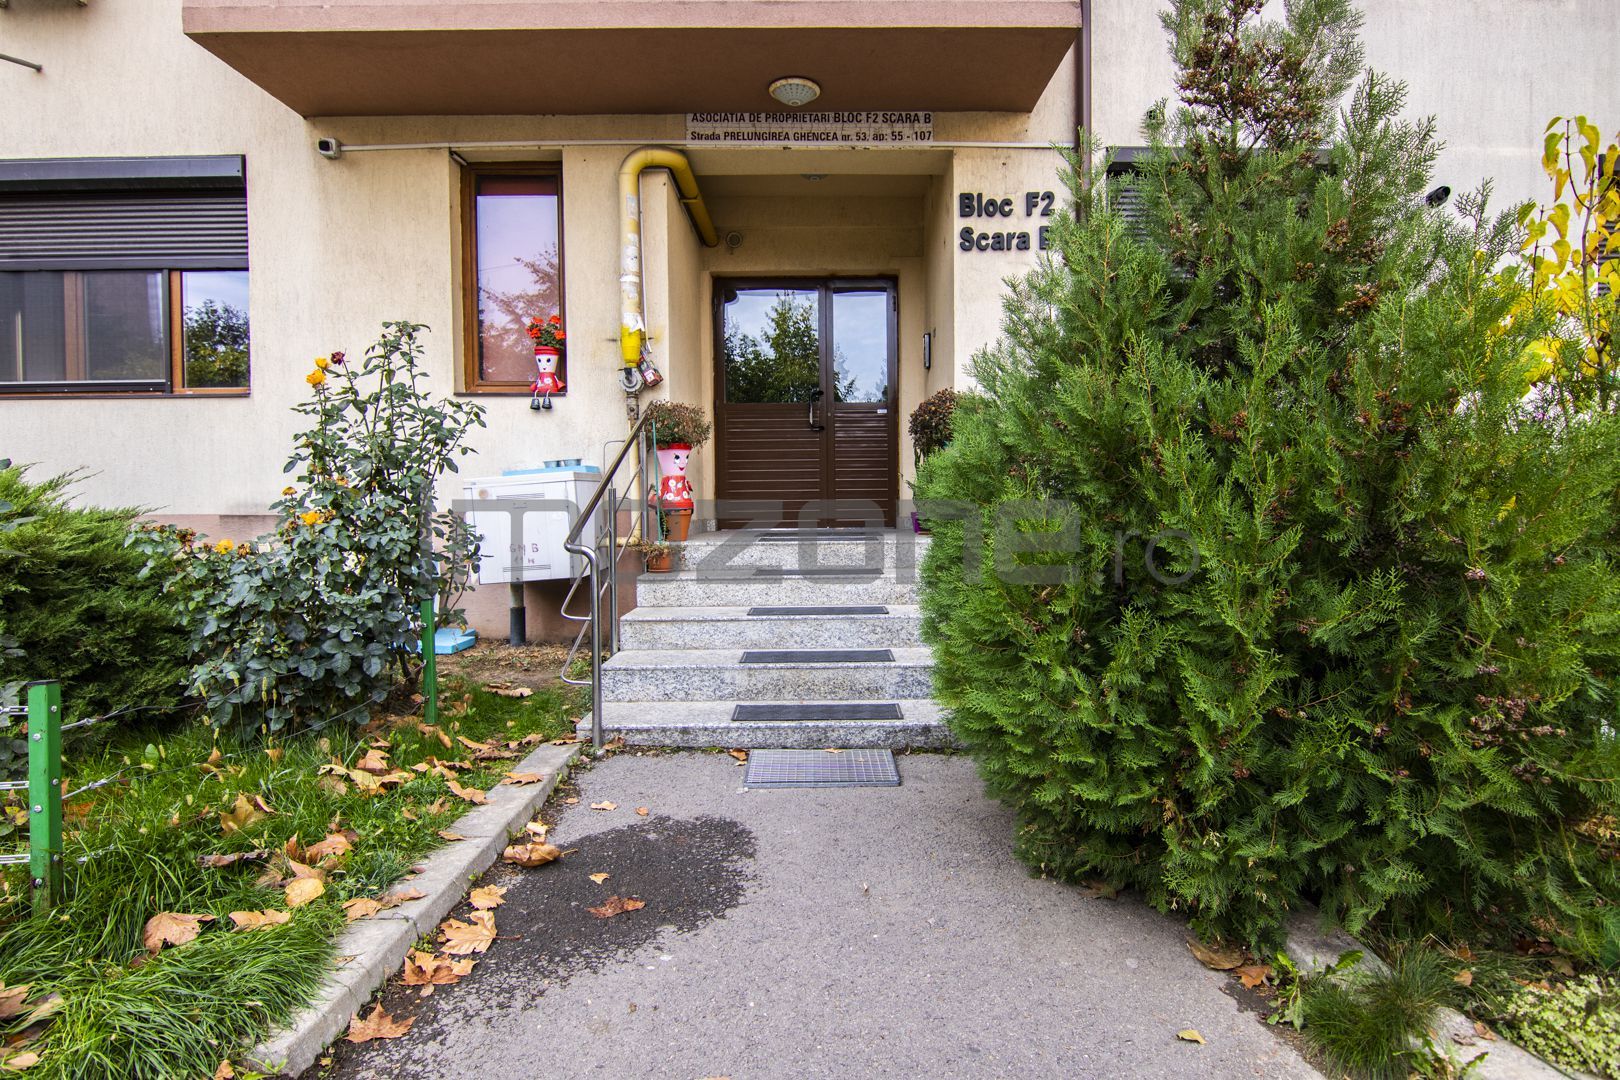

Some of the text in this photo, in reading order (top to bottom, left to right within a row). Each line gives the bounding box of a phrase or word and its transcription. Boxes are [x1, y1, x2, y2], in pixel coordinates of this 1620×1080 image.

[691, 112, 932, 124] ASOCIATIA DE PROPRIETARI BLOC F2 SCARA B
[690, 131, 720, 141] Strada
[723, 131, 790, 141] PRELUNGIREA
[793, 131, 838, 141] GHENCEA
[841, 132, 852, 141] nr.
[872, 132, 888, 143] ap:
[891, 131, 903, 141] 55
[914, 131, 932, 141] 107
[959, 191, 1055, 217] Bloc F2
[959, 226, 1030, 251] Scara
